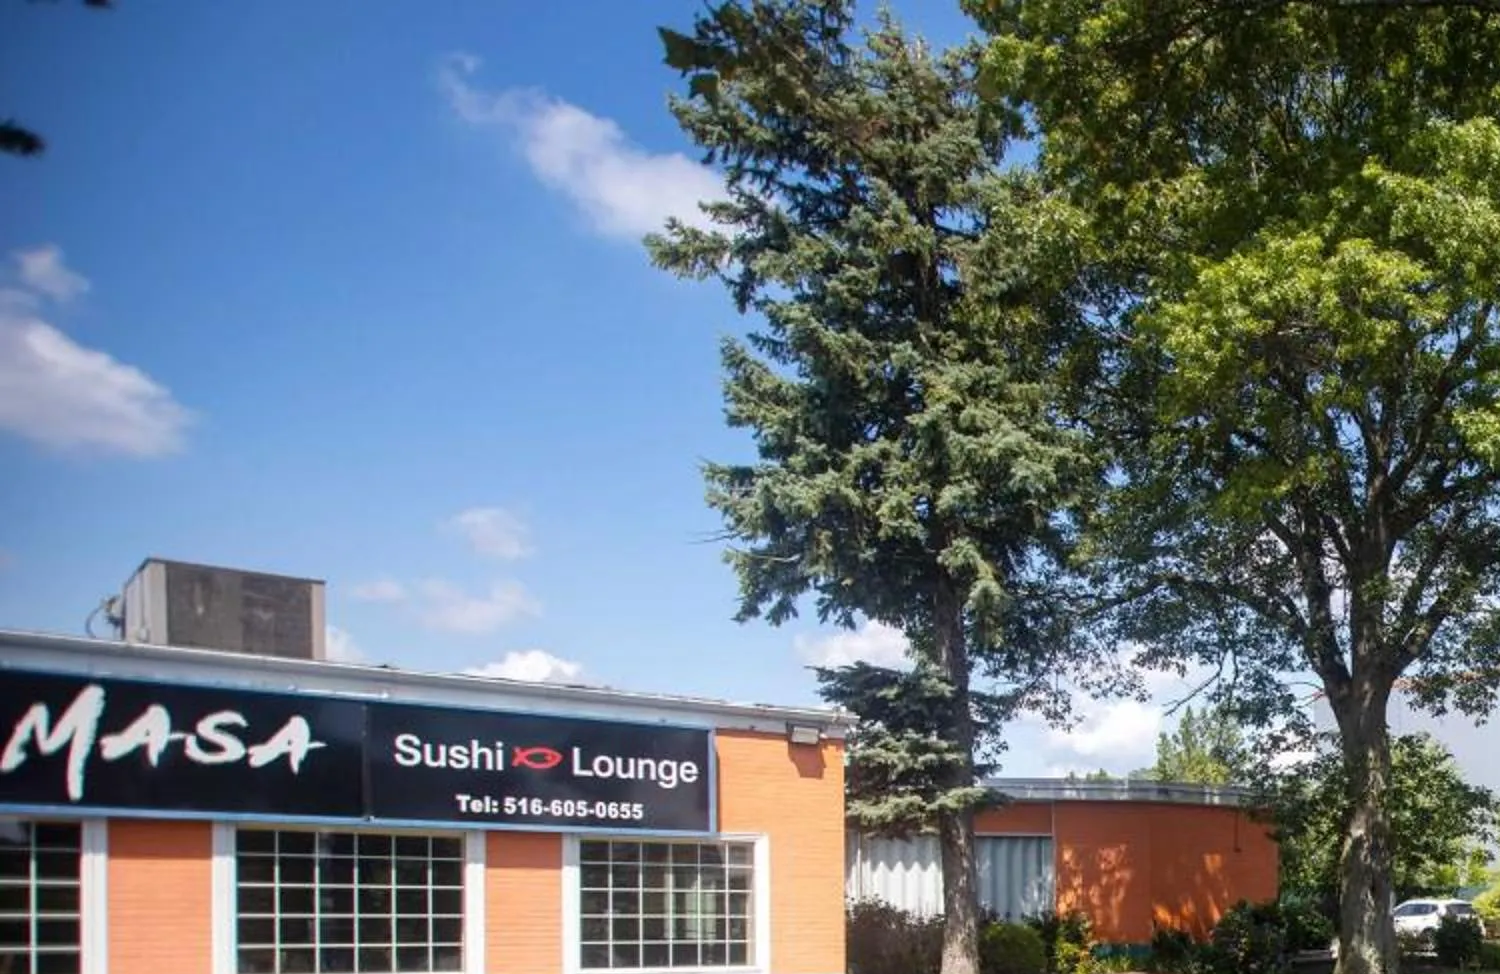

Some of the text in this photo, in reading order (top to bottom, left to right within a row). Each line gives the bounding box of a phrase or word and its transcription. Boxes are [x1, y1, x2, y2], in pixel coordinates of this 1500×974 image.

[0, 685, 326, 801] MASA
[394, 735, 699, 789] Sushi Lounge
[456, 794, 644, 821] Tel: 516-605-0655
